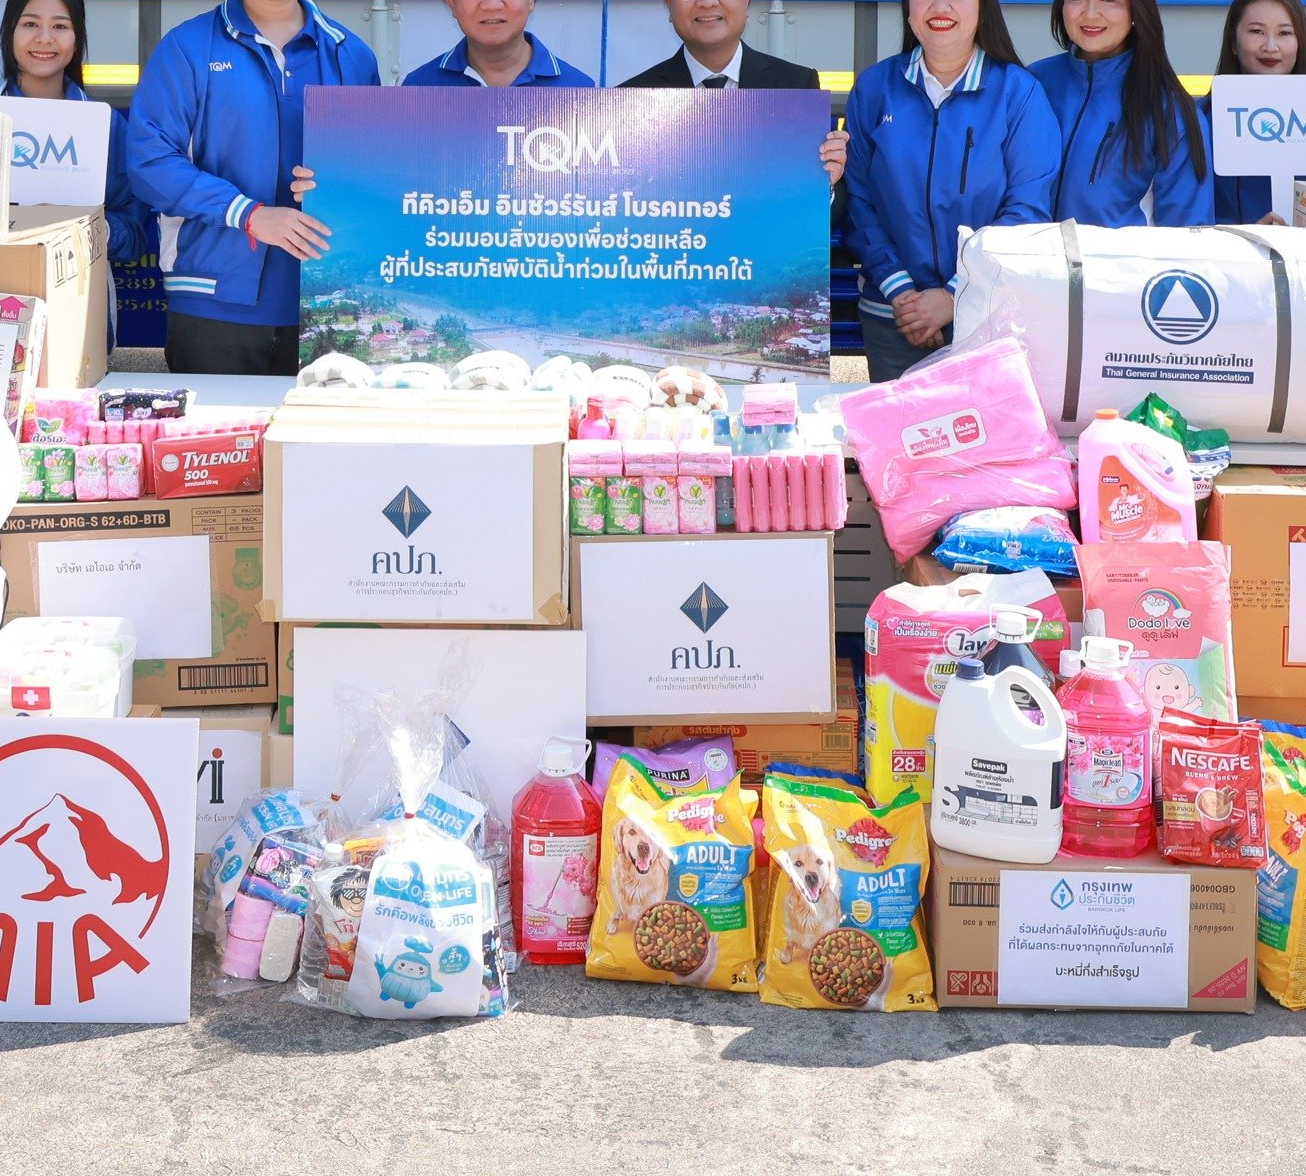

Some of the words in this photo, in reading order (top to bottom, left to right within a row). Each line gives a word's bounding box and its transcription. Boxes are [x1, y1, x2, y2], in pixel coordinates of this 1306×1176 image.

[208, 61, 233, 72] TQM
[11, 131, 78, 167] QM
[496, 125, 621, 174] TQM
[402, 191, 490, 217] ทีคิวเอ็ม
[496, 192, 618, 218] อินชัวร์รันส์
[623, 193, 732, 220] โบรคเกอร์
[425, 221, 707, 252] ร่วมมอบสิ่งของเพื่อช่วยเหลือ
[379, 249, 753, 285] ผู้ที่ประสบภัยพิบัติน้ำท่วมในพื้นที่ภาคใต้
[1105, 350, 1254, 369] สมาคมประกันวินาศภัยไทย
[1106, 368, 1124, 377] Thai
[1126, 369, 1158, 379] General
[1160, 371, 1200, 381] Insurance
[1202, 372, 1251, 383] Association
[181, 448, 250, 470] TYLENOL
[183, 469, 209, 481] 500
[101, 513, 168, 528] 62+6D-BTB
[195, 508, 222, 516] CONTAIN
[56, 561, 83, 575] บริษัท
[85, 560, 115, 574] เอไอเอ
[117, 558, 143, 572] จำกัด
[371, 544, 444, 576] คปภ.
[1128, 617, 1163, 630] Dodo
[670, 639, 743, 671] คปภ.
[893, 755, 915, 773] 28
[972, 759, 1007, 773] Savepak
[648, 769, 688, 781] PURINA
[1185, 771, 1209, 779] BLEND
[685, 846, 737, 865] ADULT
[856, 869, 906, 891] ADULT
[1080, 879, 1133, 896] กรุงเทพ
[1078, 892, 1136, 907] ประกันชีวิต
[1018, 921, 1168, 941] ร่วมส่งกำลังใจให้กับผู้ประสบภัย
[1007, 937, 1175, 957] ที่ได้ผลกระทบจากอุทกภัยในภาคใต้
[1054, 962, 1140, 981] บะหมี่กึ่งสำเร็จรูป
